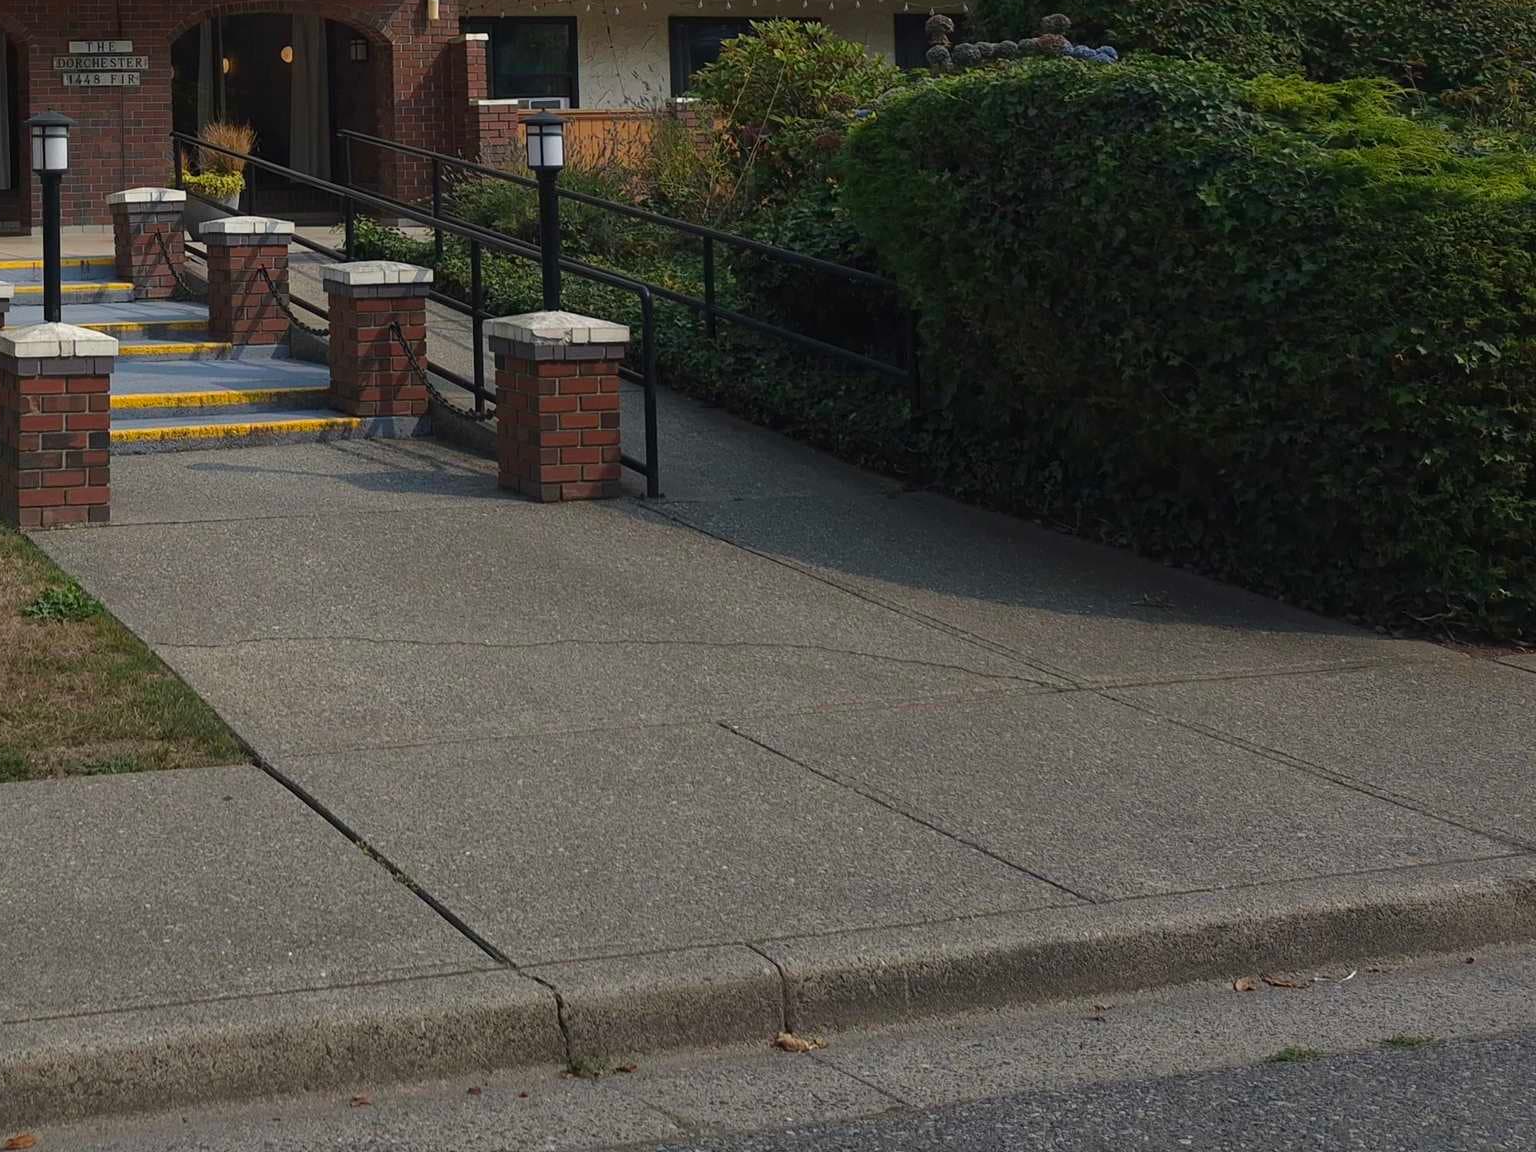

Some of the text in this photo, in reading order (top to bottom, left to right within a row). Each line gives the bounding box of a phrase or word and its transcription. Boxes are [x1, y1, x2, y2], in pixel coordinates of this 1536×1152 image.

[85, 41, 116, 52] THE
[57, 57, 144, 69] DORCHESTER
[110, 74, 136, 85] FIR
